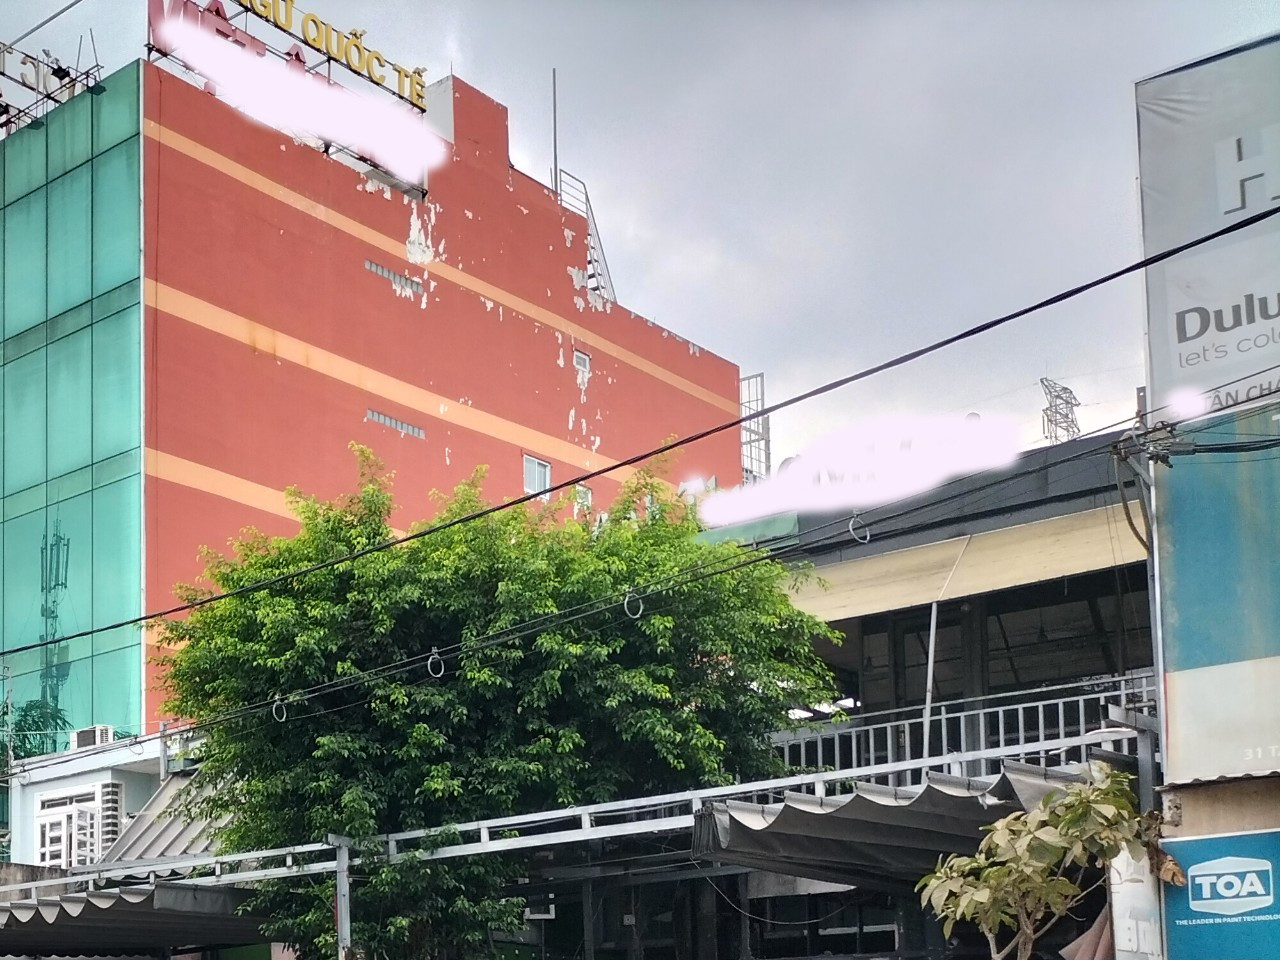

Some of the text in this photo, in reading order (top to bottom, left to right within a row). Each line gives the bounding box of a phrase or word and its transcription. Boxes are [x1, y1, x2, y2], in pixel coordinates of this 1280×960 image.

[300, 13, 387, 84] QUỐC
[392, 66, 428, 112] TẾ
[1178, 326, 1280, 368] let's col
[1195, 873, 1266, 899] TOA
